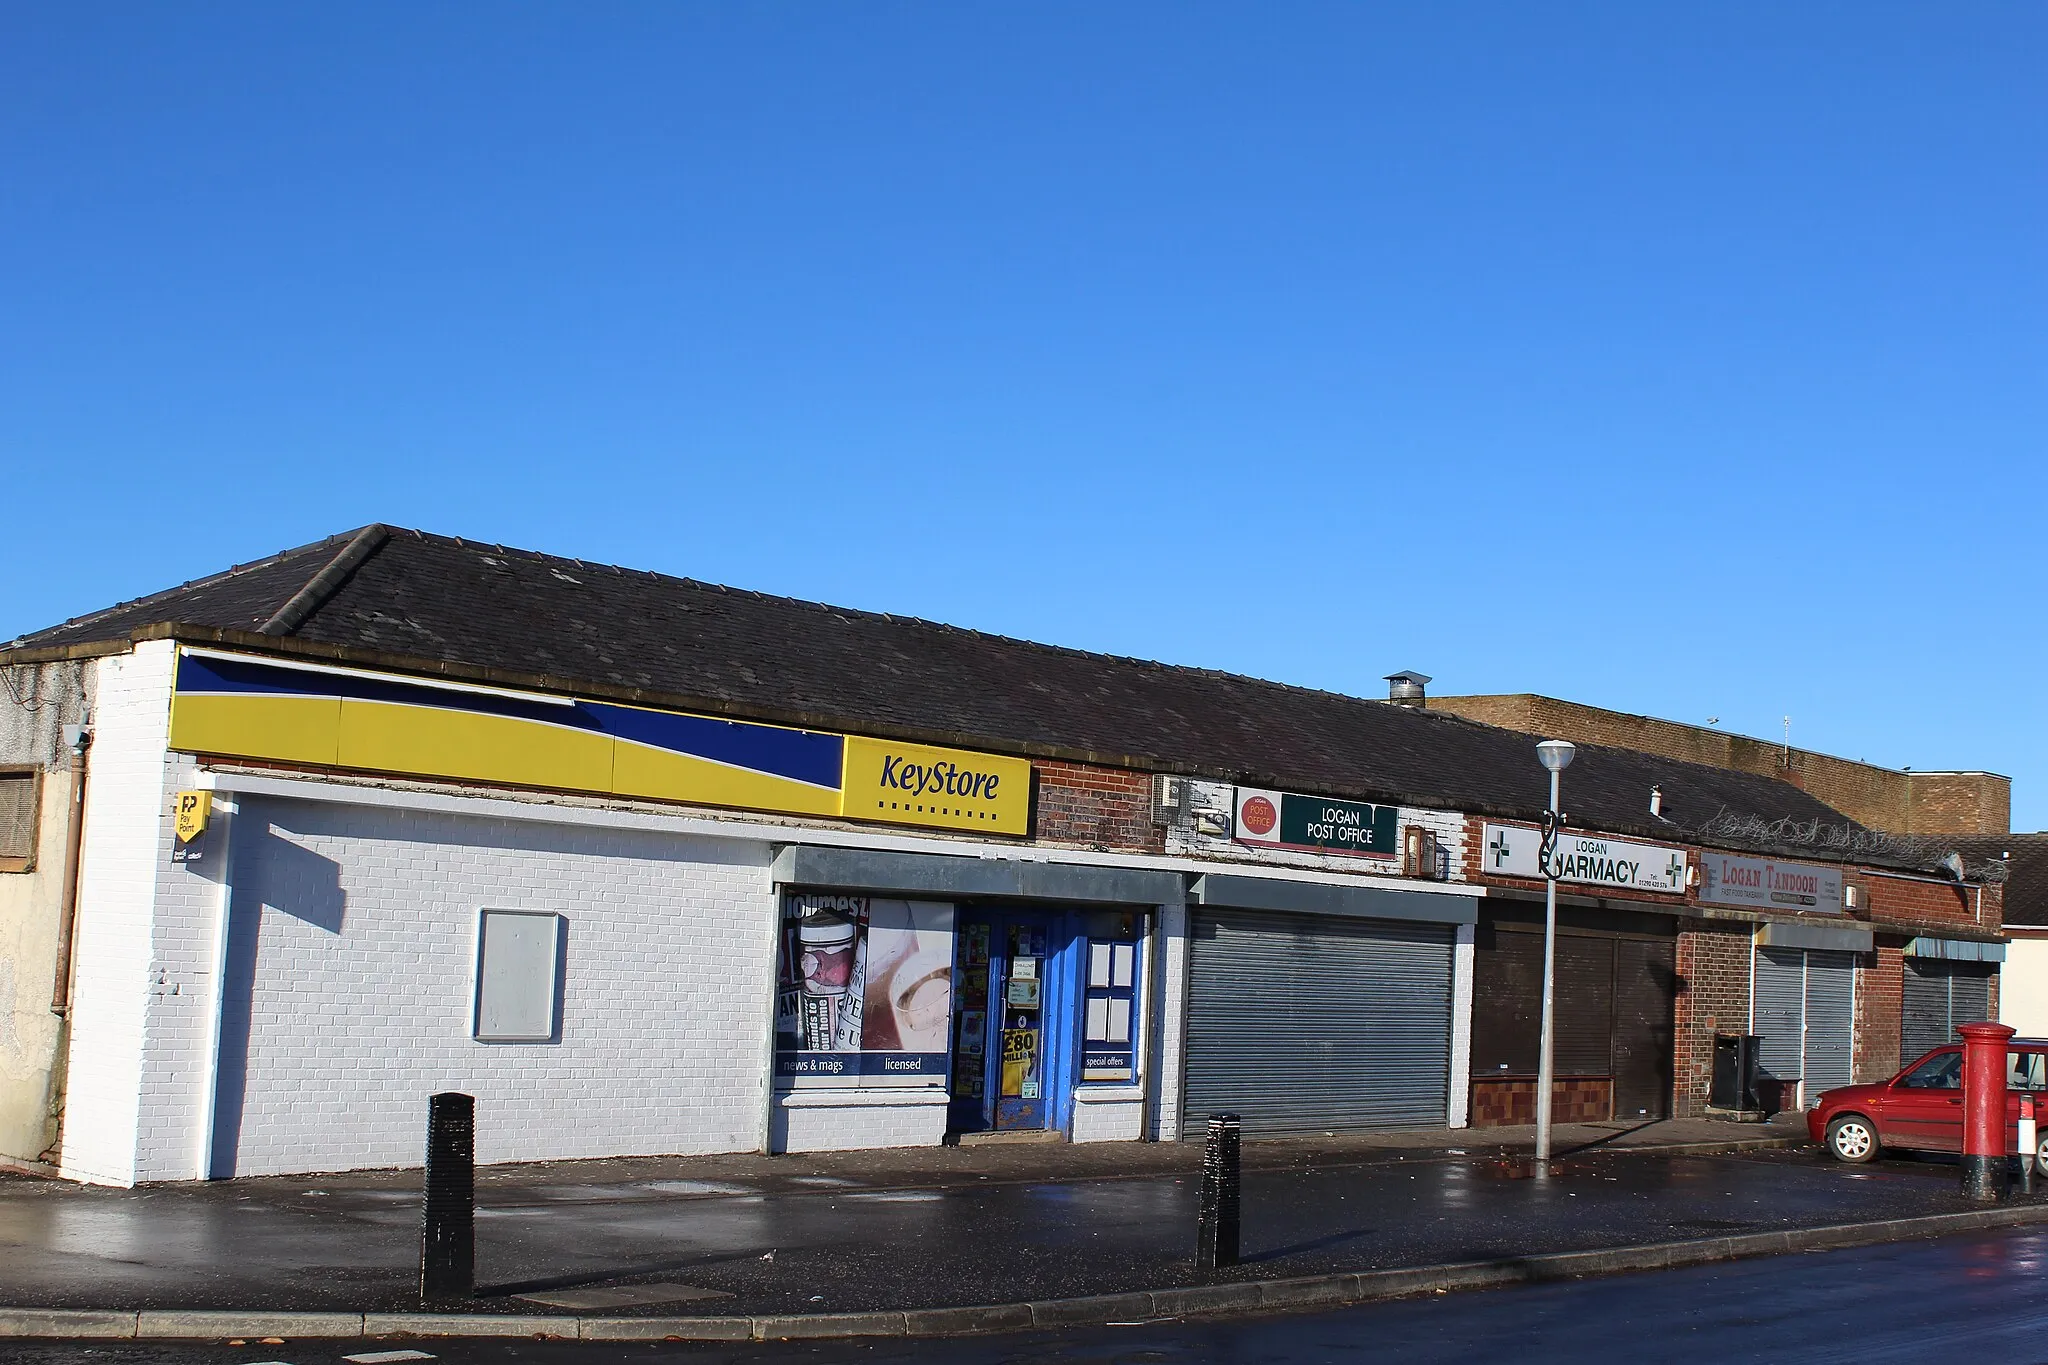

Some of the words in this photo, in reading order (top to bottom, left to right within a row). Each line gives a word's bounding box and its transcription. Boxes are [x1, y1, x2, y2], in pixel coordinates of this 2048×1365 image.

[880, 755, 1000, 800] KeyStore
[1250, 805, 1268, 816] POST
[1322, 807, 1360, 826] LOGAN
[180, 813, 191, 825] Pay
[1247, 815, 1271, 827] OFFICE
[179, 824, 195, 833] Point
[1307, 822, 1335, 840] POST
[1338, 826, 1373, 844] OFFICE
[1575, 840, 1607, 855] LOGAN
[1721, 860, 1762, 888] LOGAN
[1765, 865, 1819, 894] TANDOORI
[1720, 888, 1731, 896] FAST
[1732, 889, 1744, 898] FOOD
[819, 999, 829, 1031] home
[784, 1060, 808, 1071] news
[810, 1059, 817, 1070] &
[818, 1060, 844, 1074] mags
[885, 1057, 922, 1070] licensed
[1086, 1056, 1107, 1068] special
[1107, 1056, 1124, 1066] offers
